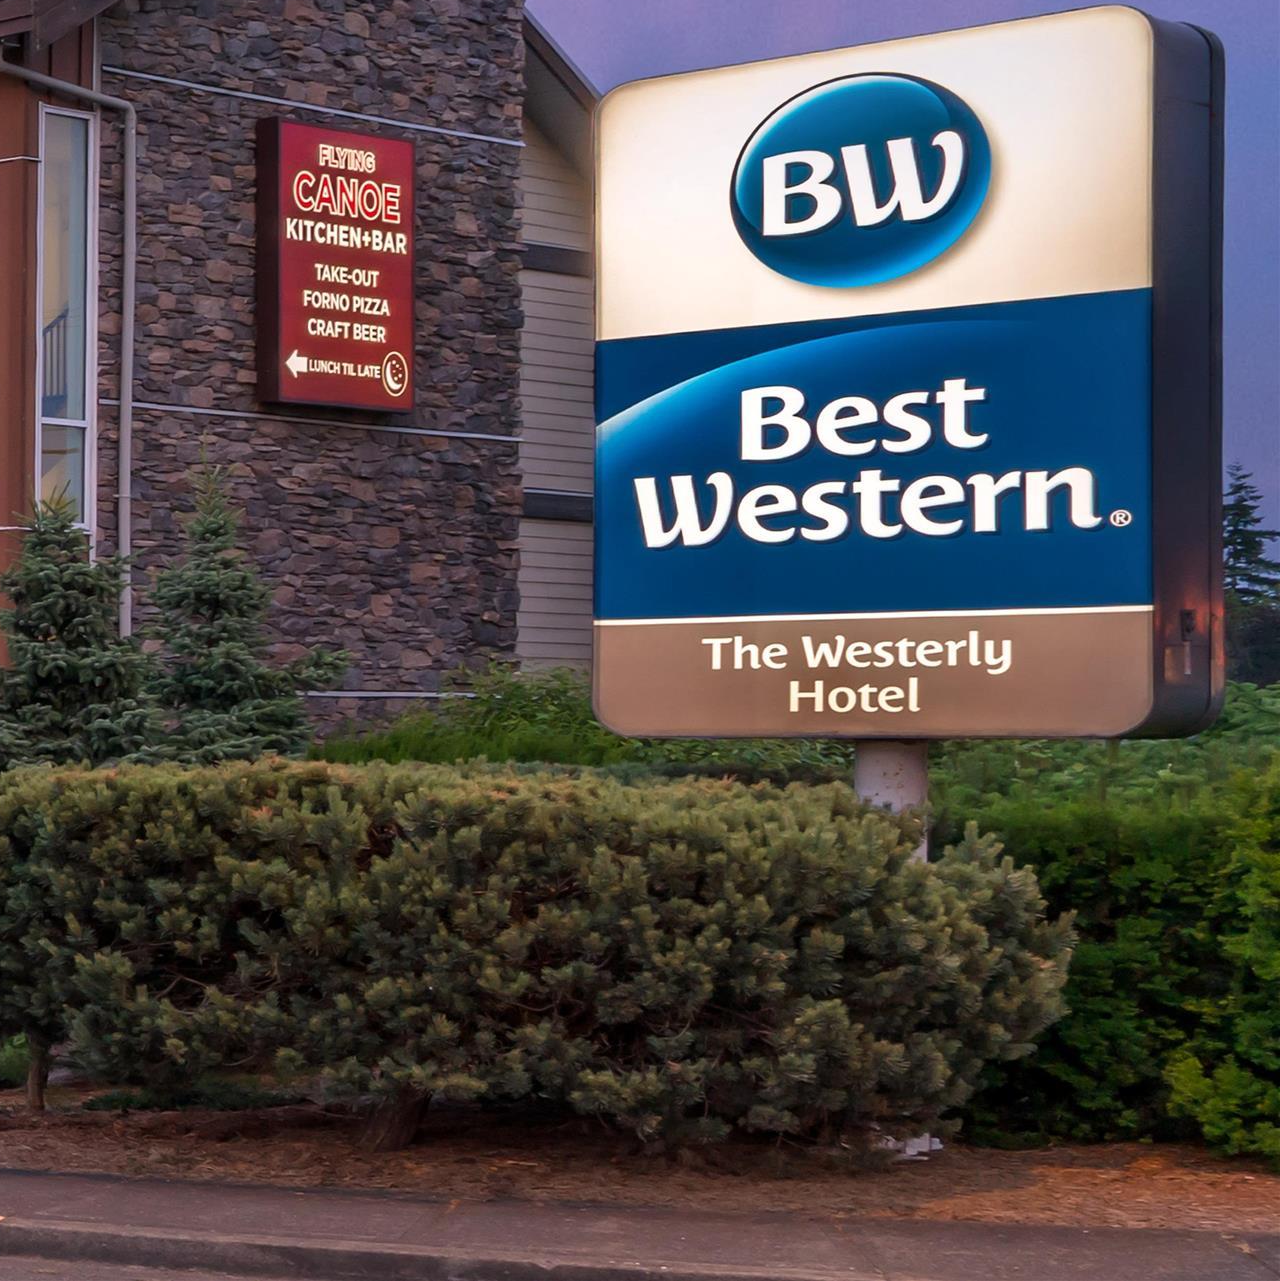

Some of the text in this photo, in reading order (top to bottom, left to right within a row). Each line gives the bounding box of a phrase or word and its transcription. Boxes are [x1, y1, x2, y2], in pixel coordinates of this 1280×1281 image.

[318, 143, 375, 173] FLYING
[293, 170, 401, 224] CANOE
[762, 130, 964, 237] BW
[314, 263, 379, 288] TAKE-OUT
[303, 289, 390, 316] FORNO PIZZA
[307, 318, 386, 343] CRAFT BEER
[308, 359, 341, 375] LUNCH
[357, 363, 381, 378] LATE
[740, 377, 989, 462] Best
[701, 630, 1013, 676] The Westerly
[789, 677, 921, 713] Hotel
